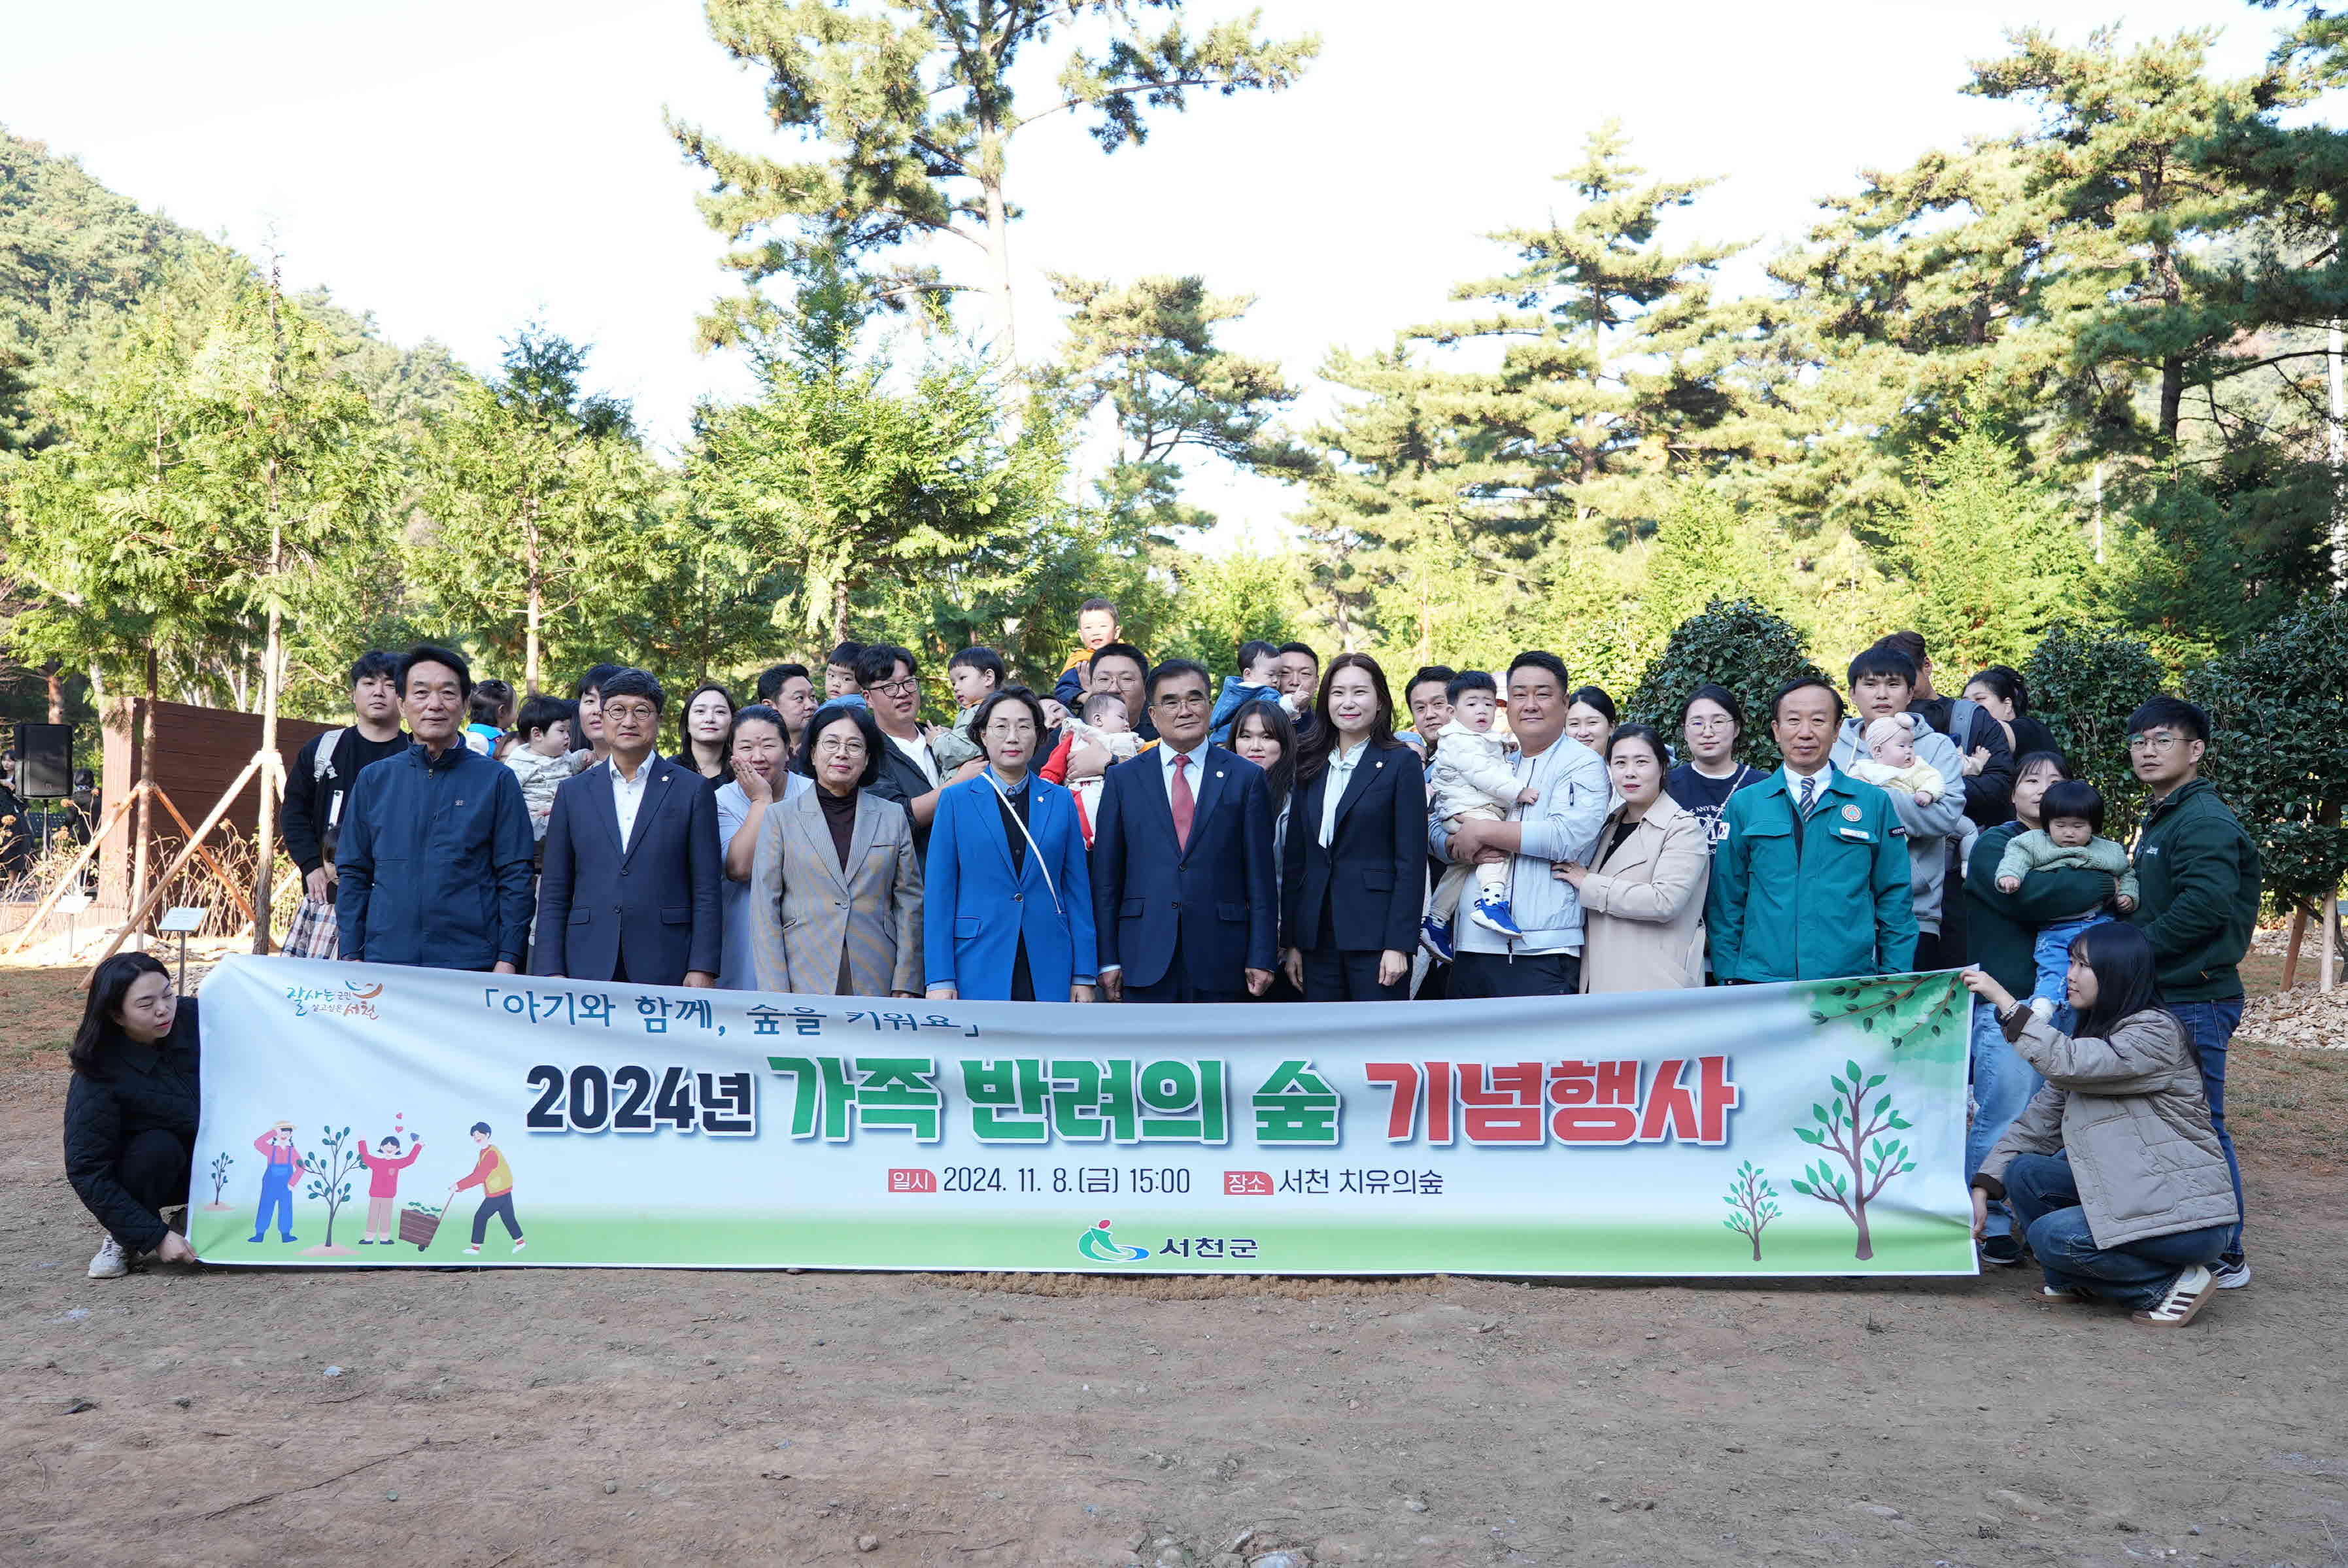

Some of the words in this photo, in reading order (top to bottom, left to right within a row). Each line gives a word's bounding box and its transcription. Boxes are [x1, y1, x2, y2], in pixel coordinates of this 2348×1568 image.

[287, 986, 335, 1016] 잘사는
[344, 1000, 379, 1020] 서천
[634, 996, 726, 1036] 함께,
[746, 1004, 827, 1036] 숲을
[526, 1065, 753, 1134] 2024년
[766, 1056, 940, 1141] 가족
[959, 1059, 1226, 1142] 반려의
[1251, 1060, 1338, 1142] 숲
[1365, 1056, 1735, 1142] 기념행사
[893, 1172, 929, 1190] 일시
[944, 1167, 1006, 1192] 2024.
[1018, 1168, 1042, 1192] 11.
[1130, 1168, 1190, 1193] 15:00
[1229, 1173, 1267, 1193] 장소
[1278, 1168, 1330, 1195] 서천
[1339, 1168, 1444, 1195] 치유의숲
[1159, 1237, 1259, 1259] 서천군
